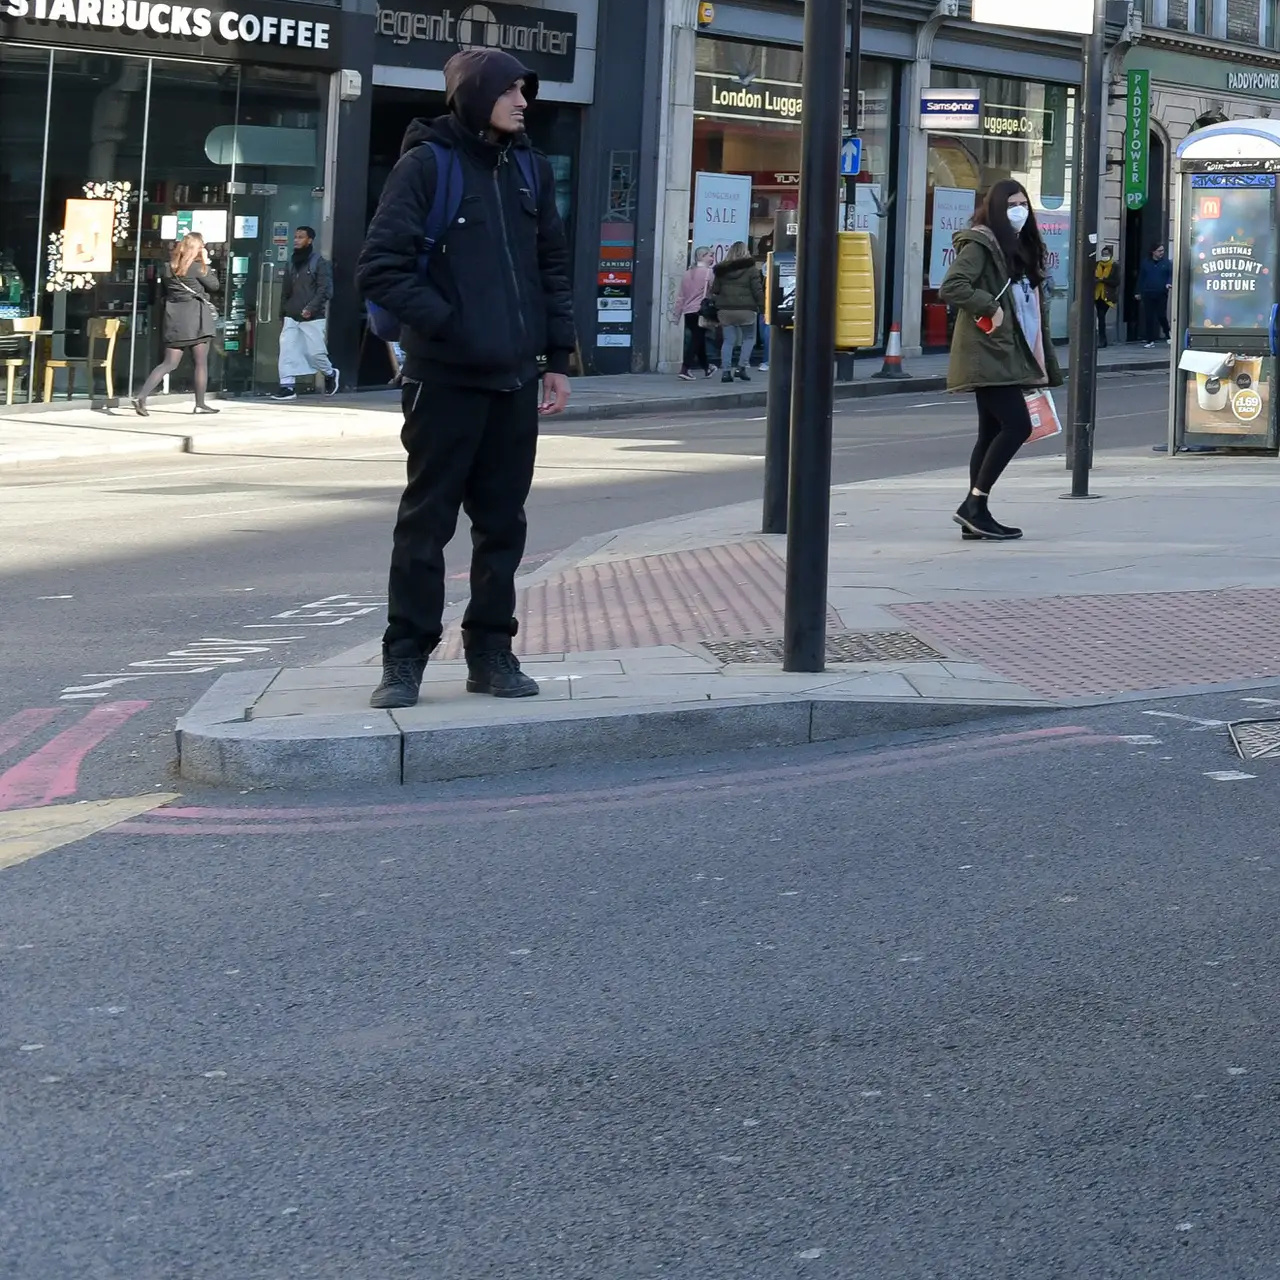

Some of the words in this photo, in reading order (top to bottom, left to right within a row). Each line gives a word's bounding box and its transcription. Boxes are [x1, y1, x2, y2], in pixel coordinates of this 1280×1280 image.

[219, 11, 330, 49] COFFEE
[1228, 73, 1280, 89] PADDYPOWER
[712, 86, 761, 108] London
[765, 91, 802, 117] Lugga
[927, 102, 974, 112] Samsonite
[984, 116, 1033, 135] uggage.Co
[1131, 74, 1143, 183] PADDYPOWER
[774, 173, 800, 183] TUM
[1127, 193, 1142, 205] PP
[705, 207, 737, 224] SALE
[940, 216, 964, 230] SALE
[1211, 246, 1252, 256] CHRISTMAS
[1202, 259, 1263, 274] SHOULDN'T
[1206, 280, 1256, 291] FORTUNE
[82, 636, 306, 677] LOOK
